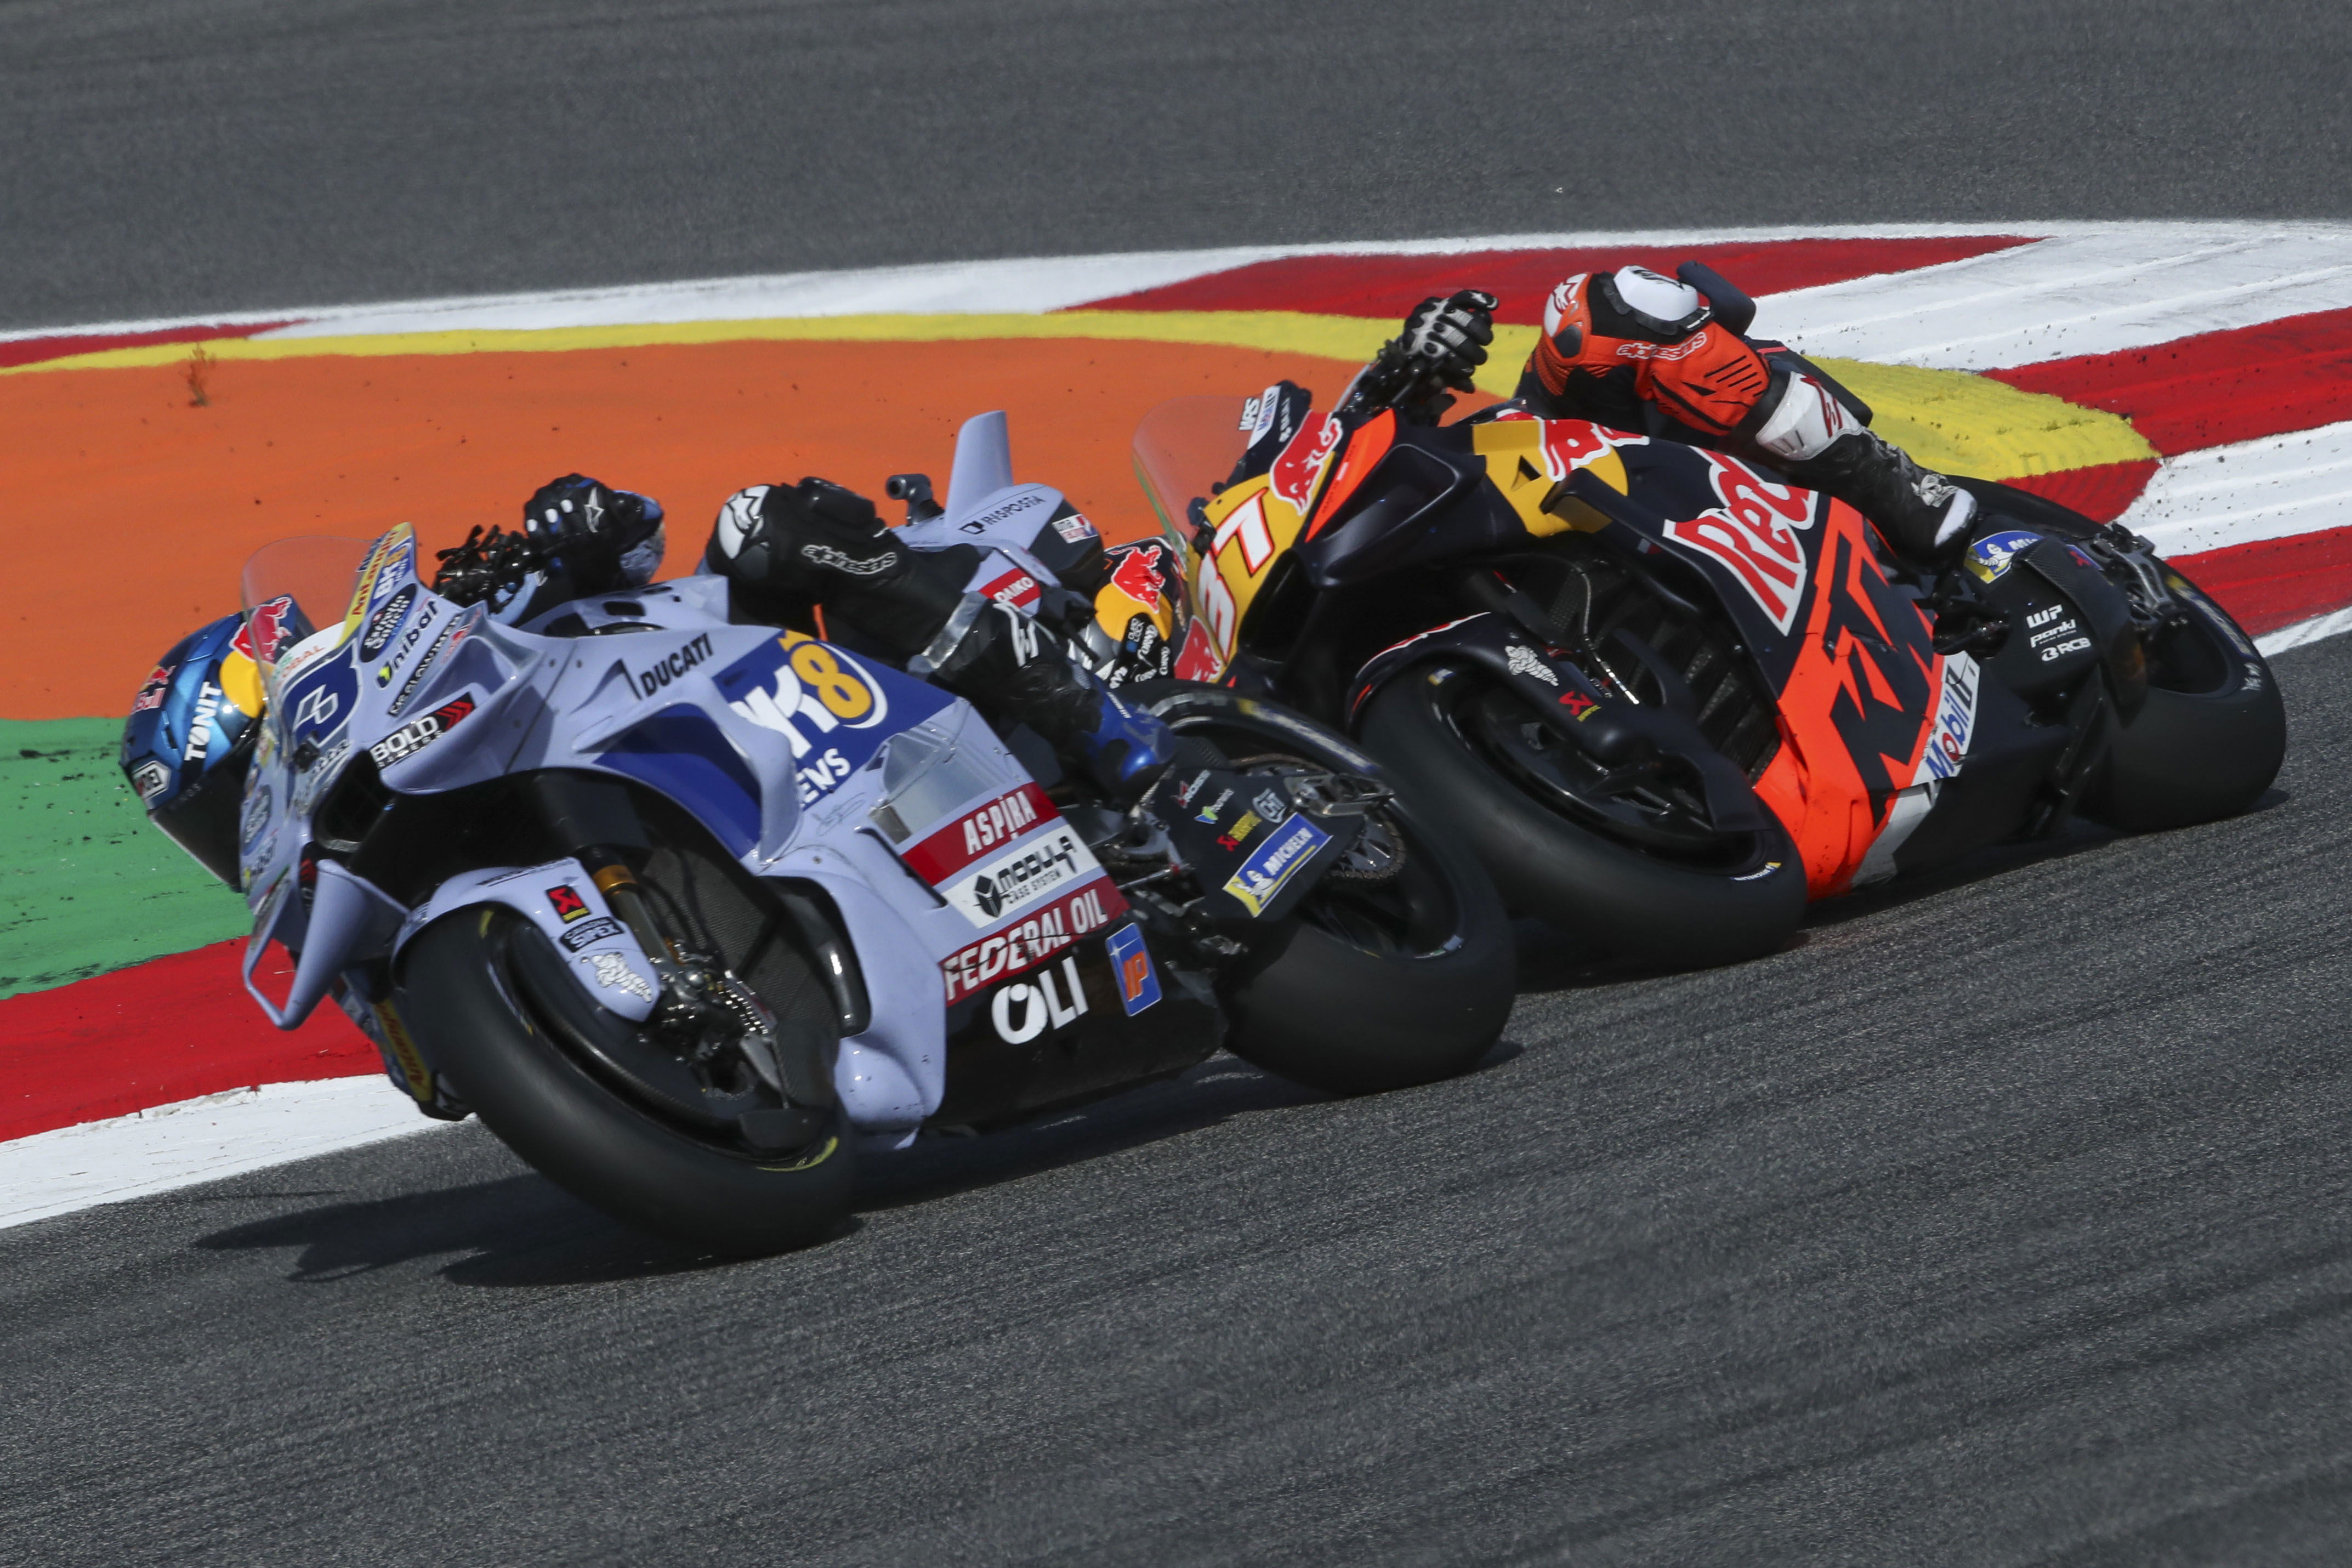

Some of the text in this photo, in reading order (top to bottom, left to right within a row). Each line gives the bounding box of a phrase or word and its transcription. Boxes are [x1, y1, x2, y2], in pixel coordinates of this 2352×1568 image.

[1238, 397, 1261, 430] WRS
[1197, 486, 1275, 667] 37
[1663, 445, 1819, 637] Red
[377, 600, 439, 689] Unibat
[639, 632, 713, 698] DUCATI
[2030, 618, 2077, 648] pankl
[370, 717, 439, 763] BOLD
[729, 644, 872, 759] K8
[1925, 691, 1970, 779] Mobil
[963, 791, 1037, 855] ASPIRA
[944, 888, 1109, 1001] FEDERAL OIL
[1123, 951, 1149, 1002] IP
[991, 956, 1089, 1045] OLI
